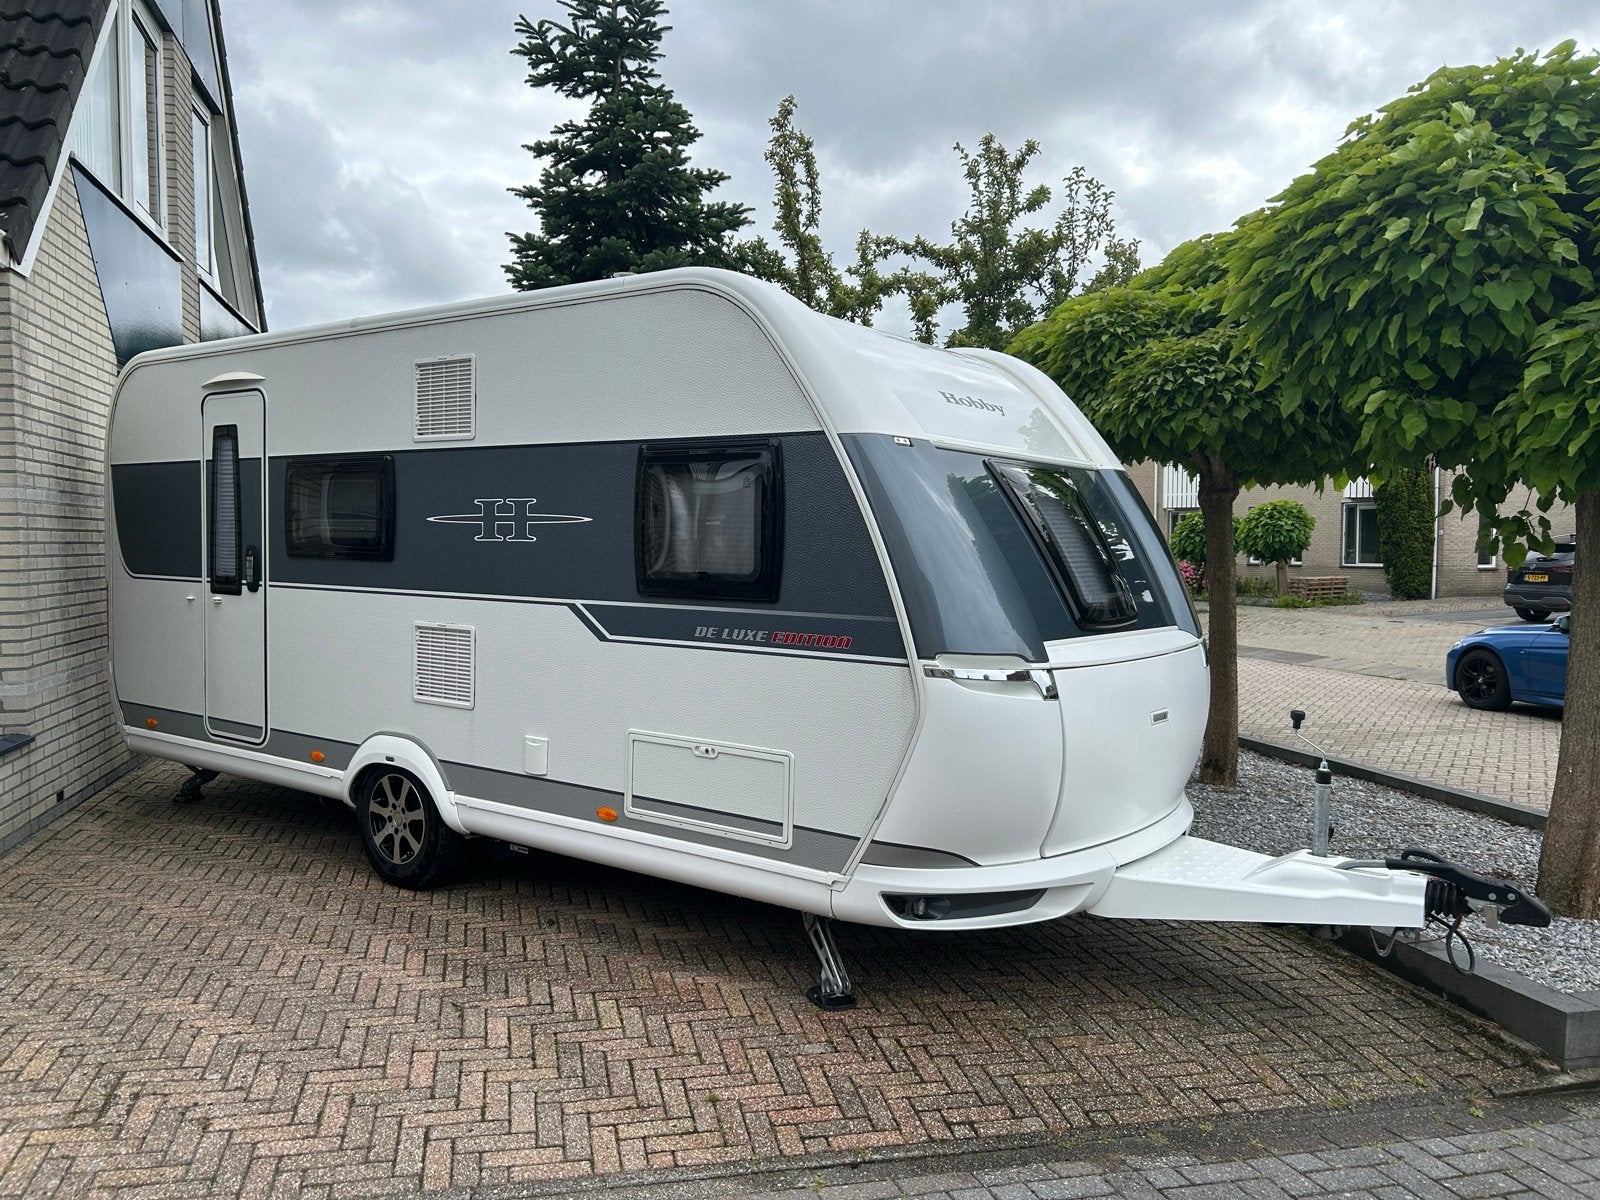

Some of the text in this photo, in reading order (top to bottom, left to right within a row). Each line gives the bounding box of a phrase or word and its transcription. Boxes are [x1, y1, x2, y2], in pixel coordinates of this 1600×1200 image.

[937, 390, 1005, 416] Hobby
[694, 626, 852, 649] DE LUXE EDITION
